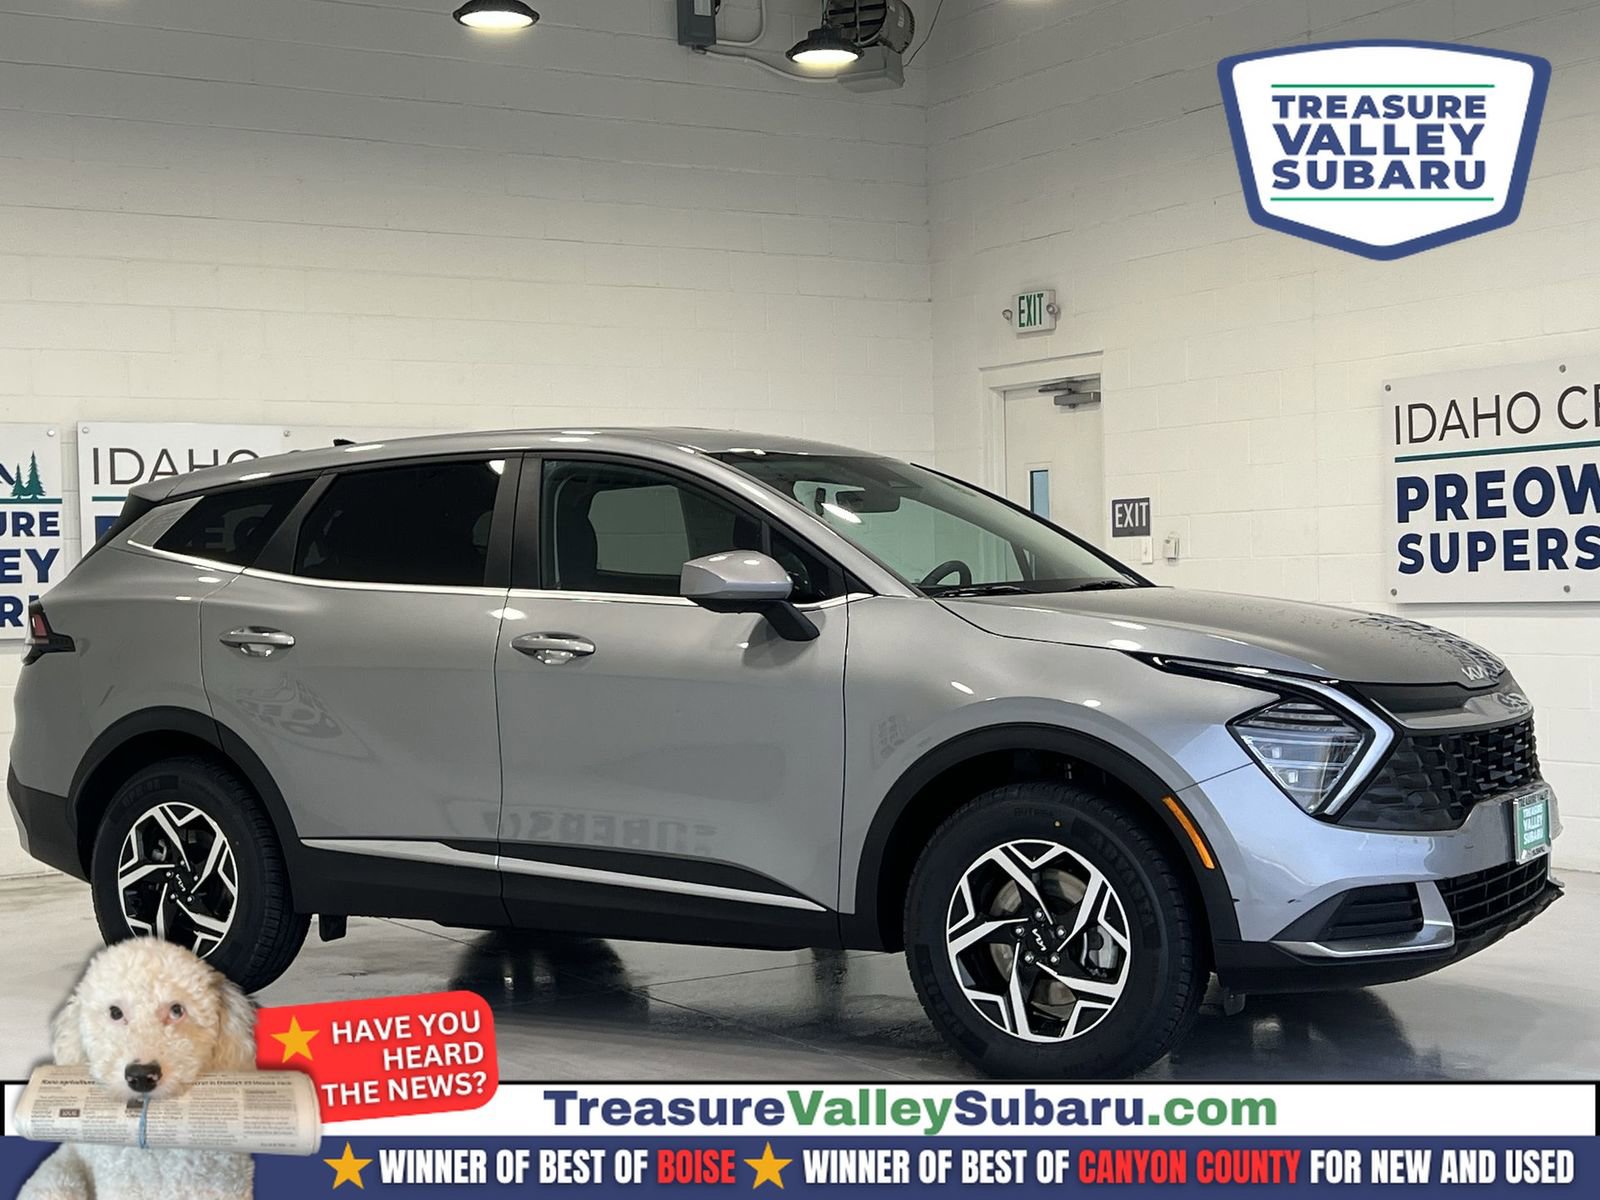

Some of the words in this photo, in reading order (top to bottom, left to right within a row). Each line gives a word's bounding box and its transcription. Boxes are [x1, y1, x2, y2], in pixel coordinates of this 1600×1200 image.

[1018, 293, 1044, 328] EXIT
[1395, 391, 1541, 445] IDAHO
[1557, 384, 1600, 430] C
[0, 511, 60, 537] RE
[1115, 501, 1149, 528] EXIT
[1398, 525, 1600, 575] SUPERS
